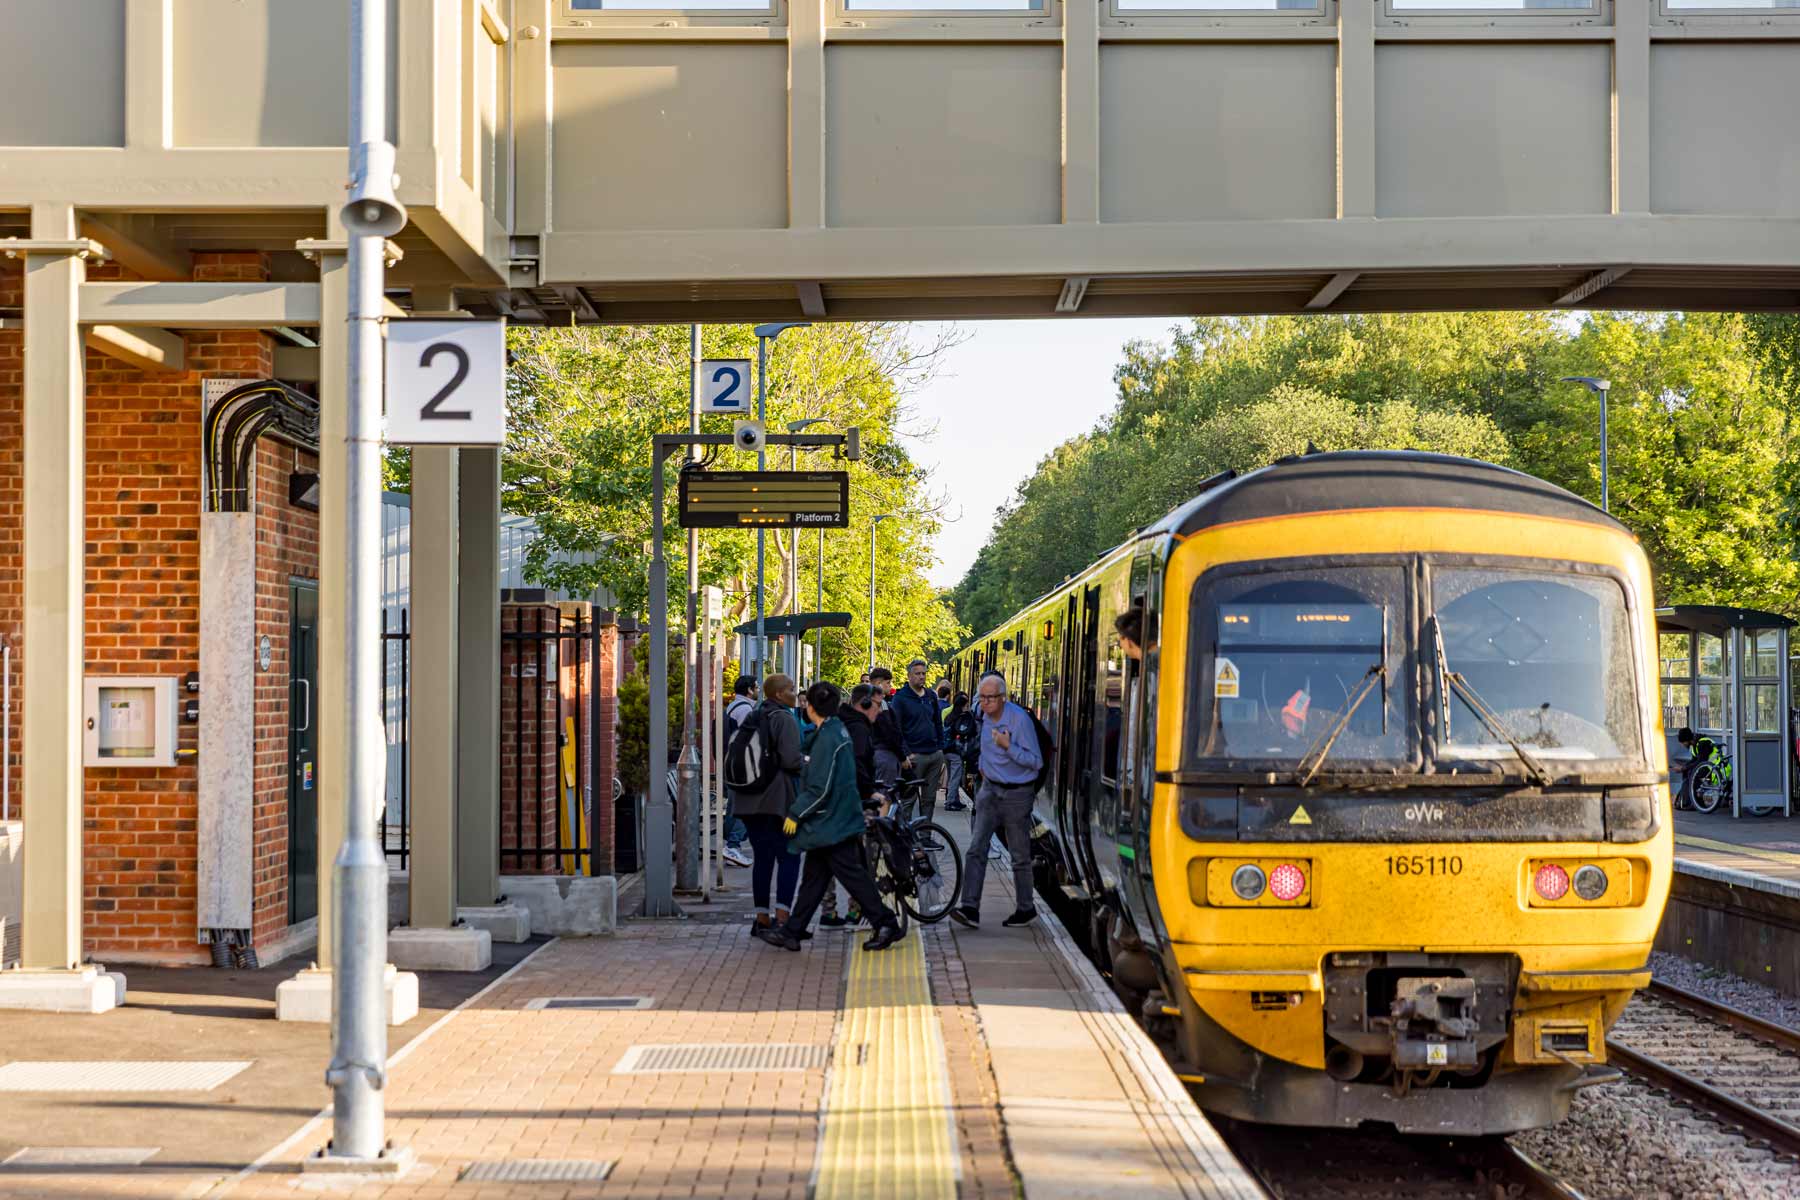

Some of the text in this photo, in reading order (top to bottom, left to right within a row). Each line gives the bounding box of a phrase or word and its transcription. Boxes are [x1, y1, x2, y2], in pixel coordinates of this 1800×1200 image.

[419, 342, 472, 421] 2
[712, 367, 740, 407] 2
[795, 513, 841, 522] Platform 2
[1405, 801, 1443, 823] GWR
[1384, 856, 1462, 876] 165110
